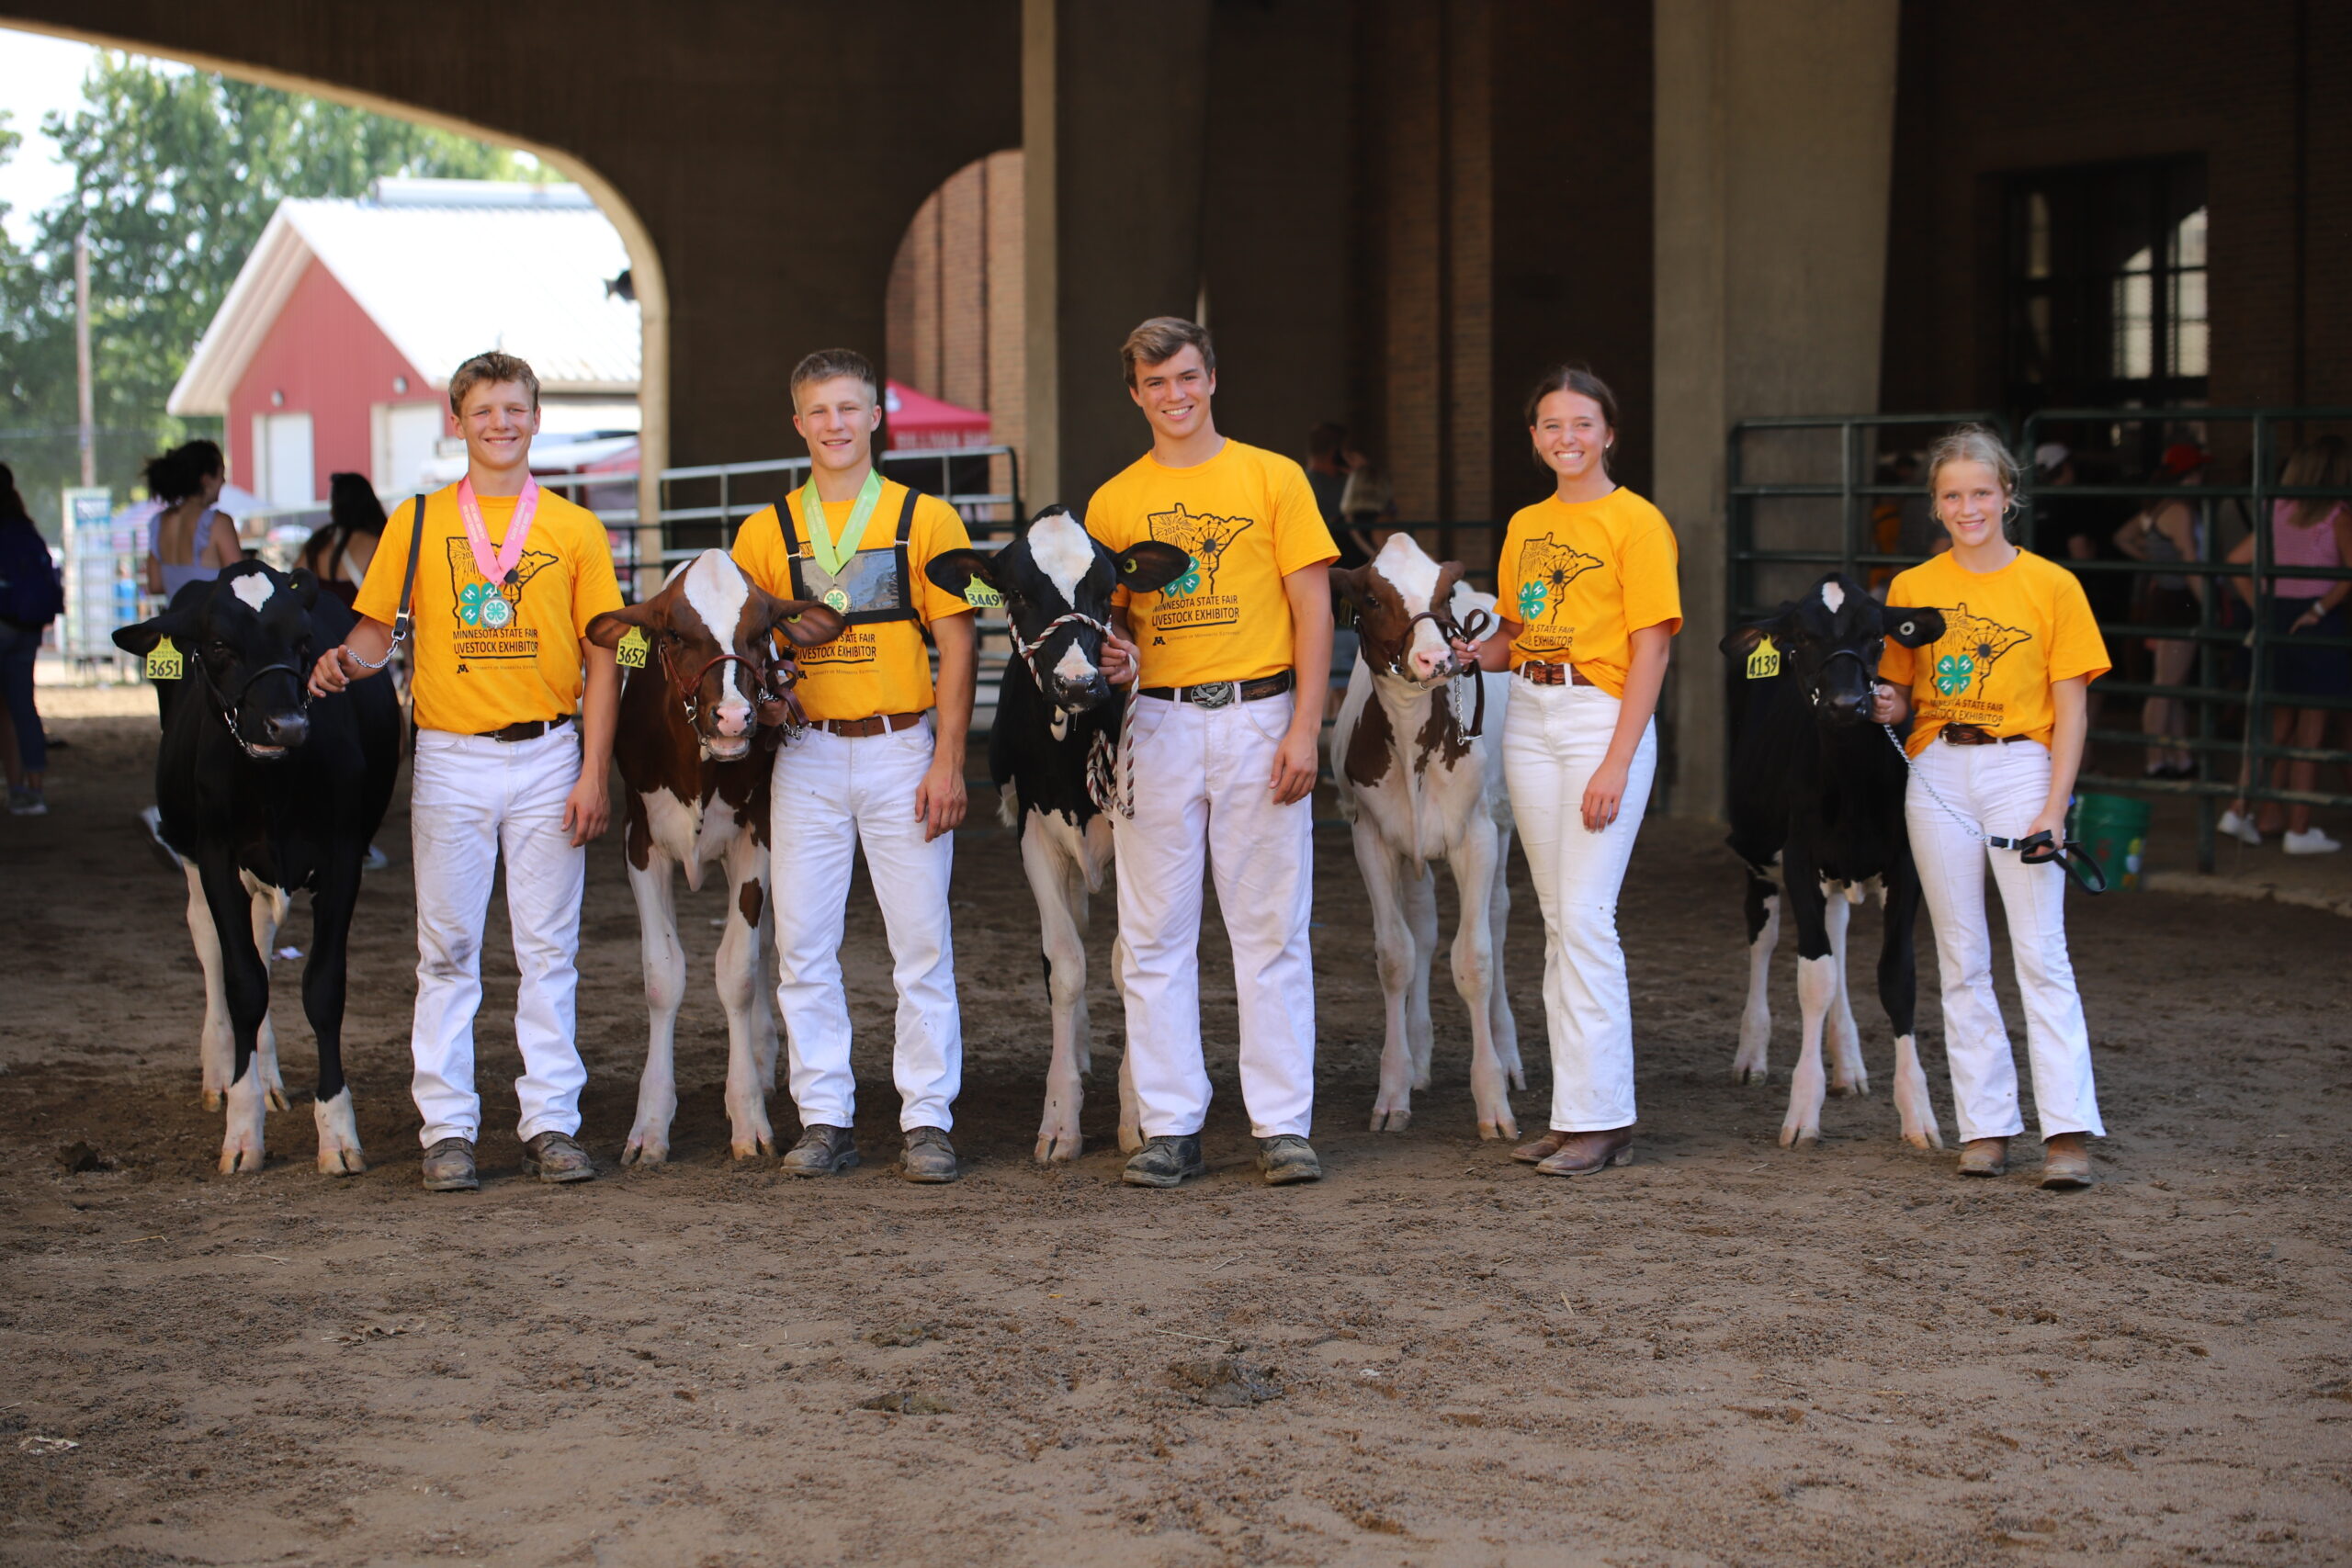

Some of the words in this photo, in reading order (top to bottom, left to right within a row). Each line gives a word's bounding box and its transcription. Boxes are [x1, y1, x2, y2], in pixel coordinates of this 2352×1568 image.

[462, 552, 474, 560] 202
[967, 593, 1000, 606] 3449
[1152, 598, 1194, 613] MINNESOTA
[1196, 595, 1220, 606] STATE
[1221, 595, 1238, 604] FAIR
[1151, 610, 1193, 626] LIVESTOCK
[1195, 607, 1239, 621] EXHIBITOR
[453, 628, 498, 639] MINNESOTA
[500, 628, 523, 638] STATE
[525, 628, 538, 638] FAIR
[1536, 624, 1558, 634] STATE
[1558, 626, 1575, 634] FAIR
[859, 634, 876, 643] FAIR
[1533, 636, 1573, 647] EXHIBITOR
[454, 641, 497, 654] LIVESTOCK
[499, 640, 538, 653] EXHIBITOR
[838, 646, 876, 658] EXHIBITOR
[617, 646, 646, 667] 3652
[149, 660, 181, 677] 3651
[1749, 654, 1778, 677] 4139
[1962, 699, 1985, 710] STATE
[1986, 702, 2004, 712] FAIR
